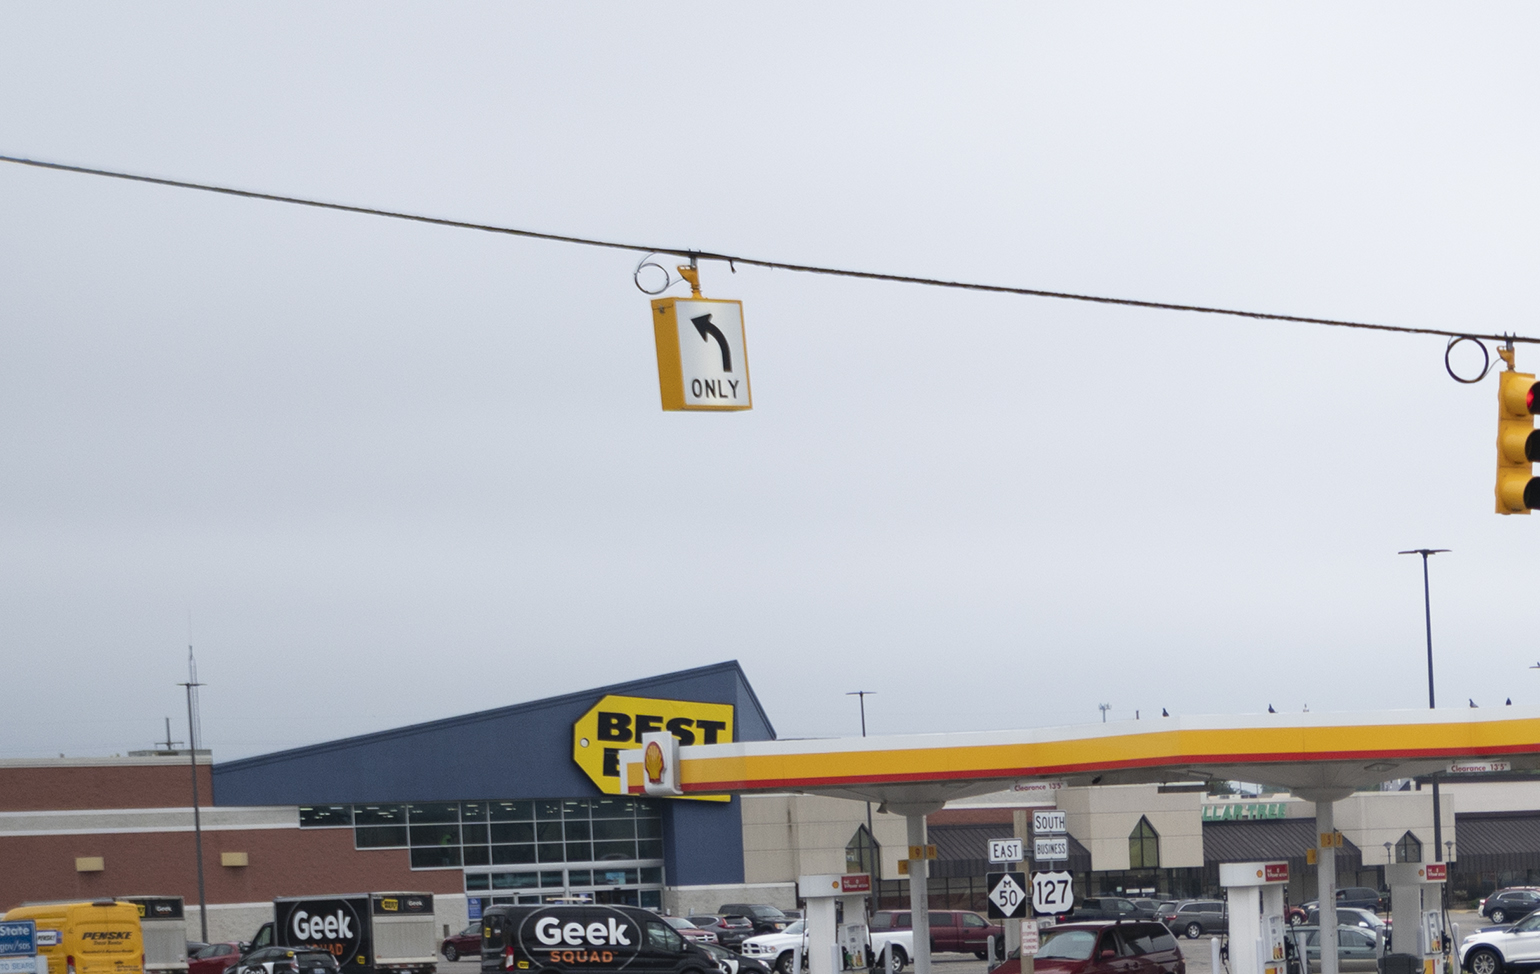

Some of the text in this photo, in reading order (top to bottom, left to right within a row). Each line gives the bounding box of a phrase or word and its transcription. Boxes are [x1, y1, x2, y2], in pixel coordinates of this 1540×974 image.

[691, 378, 739, 399] ONLY
[597, 711, 726, 747] BEST
[1451, 764, 1486, 773] Clearance
[1014, 784, 1046, 792] Clearance
[1202, 803, 1287, 821] LLAR TREE
[1035, 815, 1065, 831] SOUTH
[993, 843, 1018, 859] EAST
[1036, 843, 1066, 856] BUSINESS
[1003, 880, 1011, 888] M
[999, 890, 1017, 907] 50
[1037, 880, 1069, 905] 127
[0, 925, 30, 936] State
[293, 909, 354, 941] Geek
[534, 916, 631, 947] Geek
[82, 931, 133, 940] PENSKE
[550, 950, 614, 963] SQUAD
